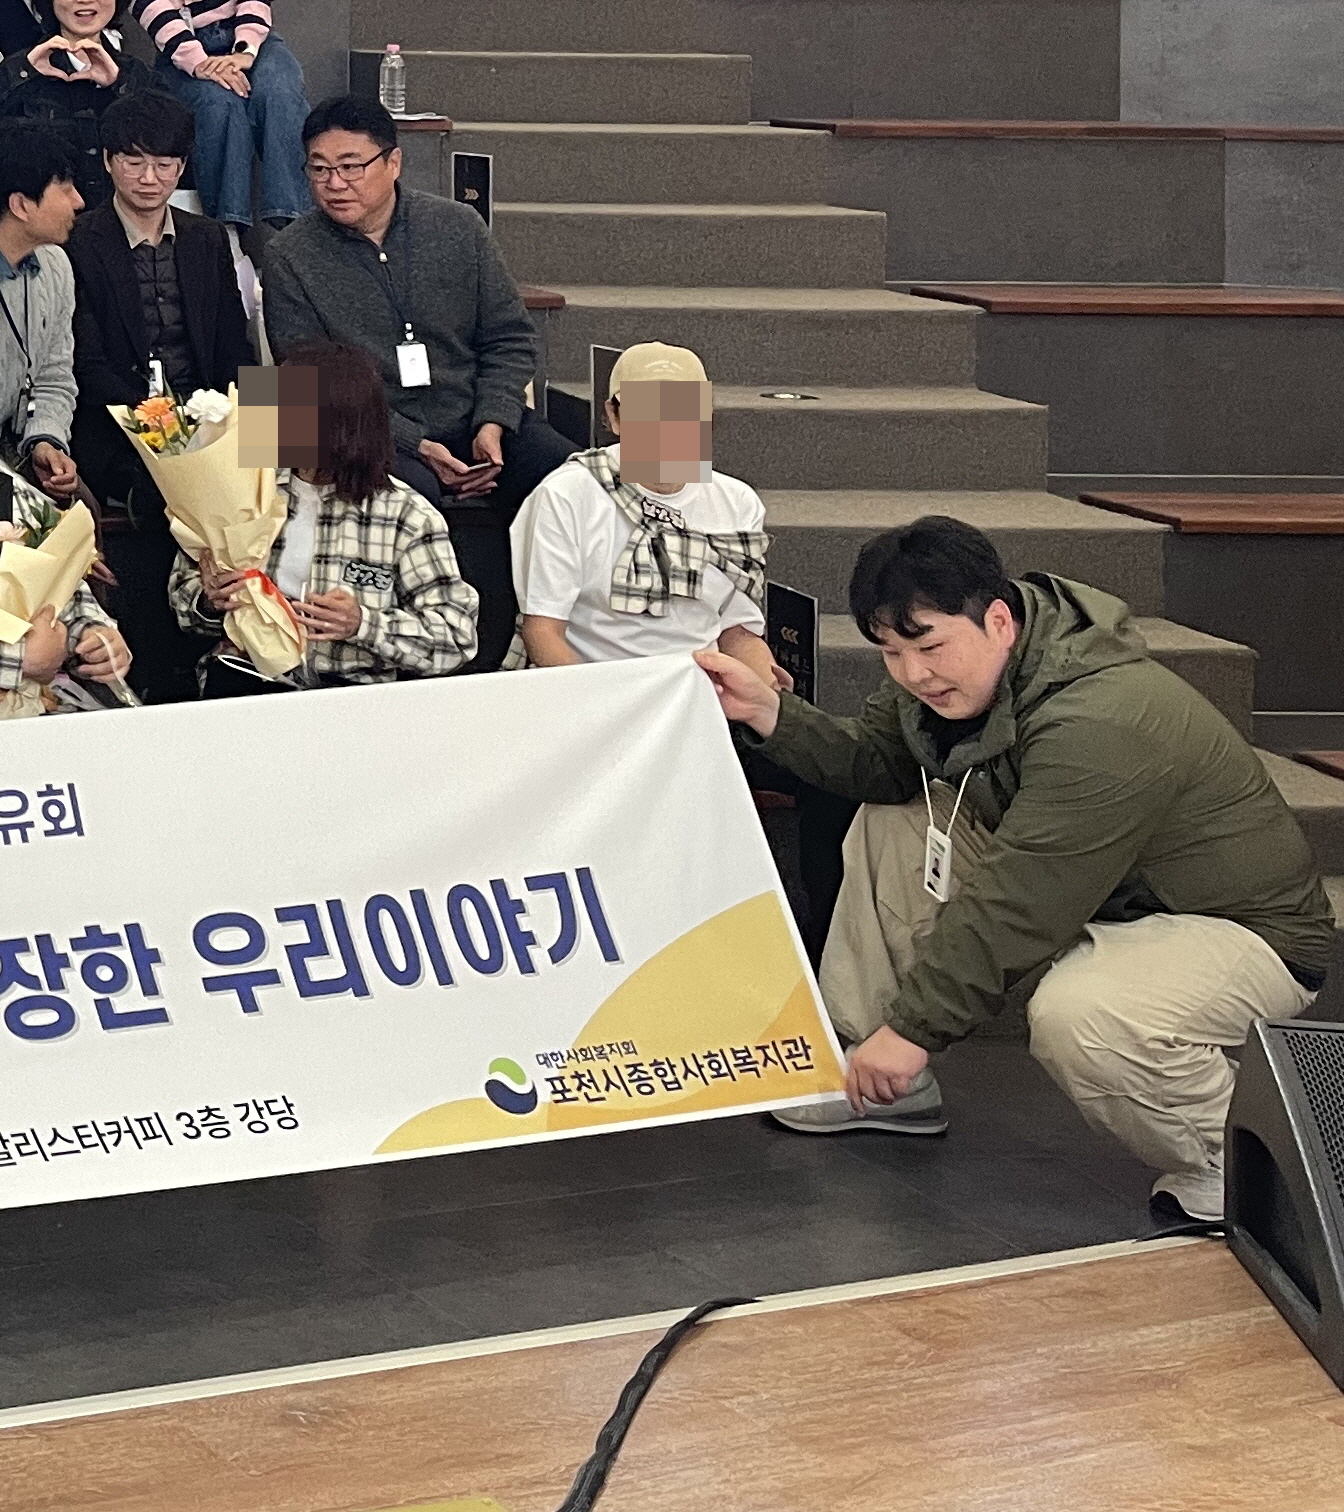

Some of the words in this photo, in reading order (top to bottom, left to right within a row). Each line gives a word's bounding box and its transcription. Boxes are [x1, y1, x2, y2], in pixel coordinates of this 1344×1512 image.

[189, 866, 624, 1015] 우리이야기
[535, 1039, 639, 1069] 대한사회복지회
[544, 1036, 815, 1104] 포천시종합사회복지관
[174, 1103, 232, 1140] 3층
[233, 1094, 301, 1135] 강당
